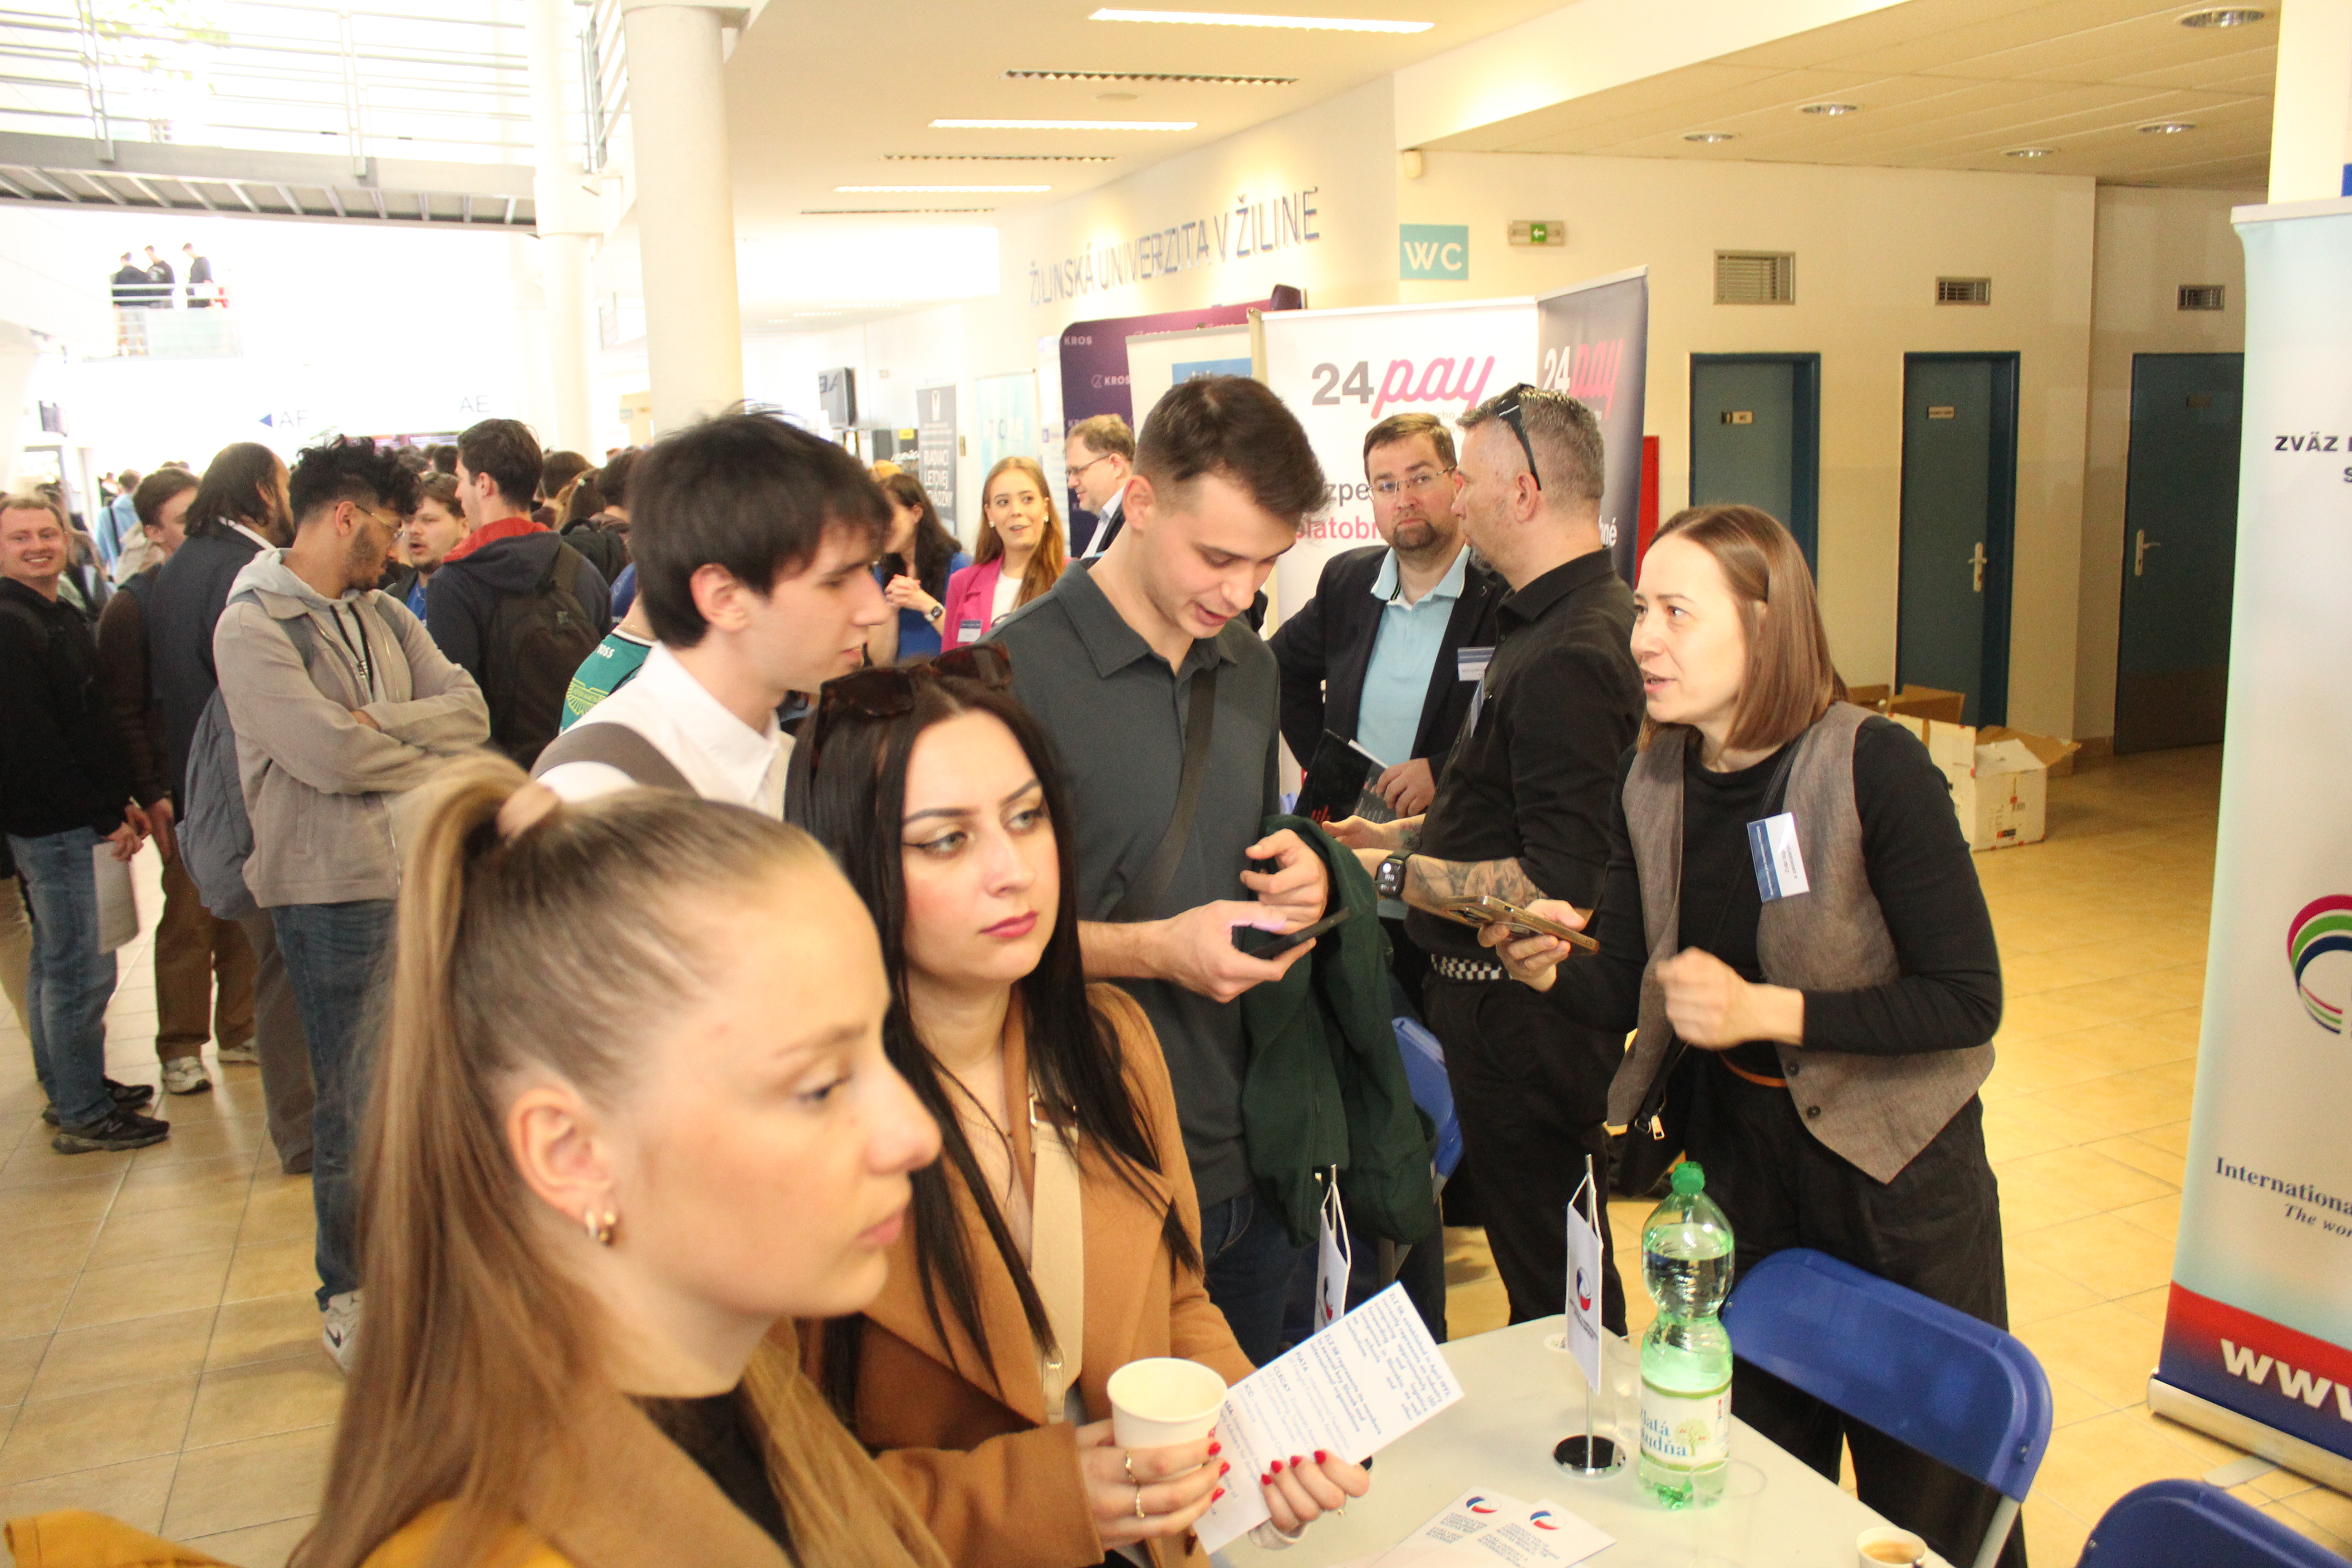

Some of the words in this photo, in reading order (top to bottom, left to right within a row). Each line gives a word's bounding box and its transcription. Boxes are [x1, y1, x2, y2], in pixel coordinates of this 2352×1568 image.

[1030, 242, 1095, 306] ŽILINSKÁ
[1098, 219, 1210, 290] UNIVERZITA
[1214, 212, 1229, 262] V
[1236, 186, 1319, 257] ŽILINE
[1404, 241, 1462, 270] WC
[1064, 336, 1093, 345] KROS
[279, 410, 308, 428] AF
[459, 395, 490, 413] AE
[2274, 431, 2338, 451] ZVÄZ
[2285, 1203, 2318, 1225] The
[1295, 1351, 1308, 1372] FIATA
[1352, 1316, 1358, 1324] as
[1364, 1338, 1380, 1362] schools
[1386, 1376, 1397, 1389] and
[1401, 1403, 1412, 1421] other
[1359, 1311, 1381, 1347] companies
[1381, 1348, 1387, 1357] in
[1404, 1391, 1411, 1400] as
[1410, 1402, 1421, 1416] well
[1367, 1306, 1388, 1343] forwarding
[1395, 1357, 1406, 1370] and
[1410, 1382, 1427, 1412] logistics
[1374, 1302, 1396, 1339] comprising
[1397, 1343, 1426, 1391] approximately
[1382, 1298, 1400, 1327] currently
[1398, 1328, 1420, 1363] represents
[1420, 1365, 1426, 1374] an
[1426, 1374, 1442, 1403] industry
[1402, 1317, 1429, 1355] established
[1425, 1355, 1431, 1363] in
[1429, 1364, 1441, 1380] April
[1244, 1383, 1254, 1397] ICC
[1273, 1365, 1291, 1392] CLECAT
[1309, 1343, 1337, 1385] international
[1333, 1386, 1360, 1432] organisations
[1321, 1346, 1339, 1370] several
[1335, 1370, 1343, 1383] key
[1343, 1383, 1357, 1407] Slovak
[1355, 1407, 1366, 1421] and
[1337, 1356, 1358, 1392] represents
[1362, 1403, 1381, 1435] members
[1641, 1408, 1670, 1436] latá
